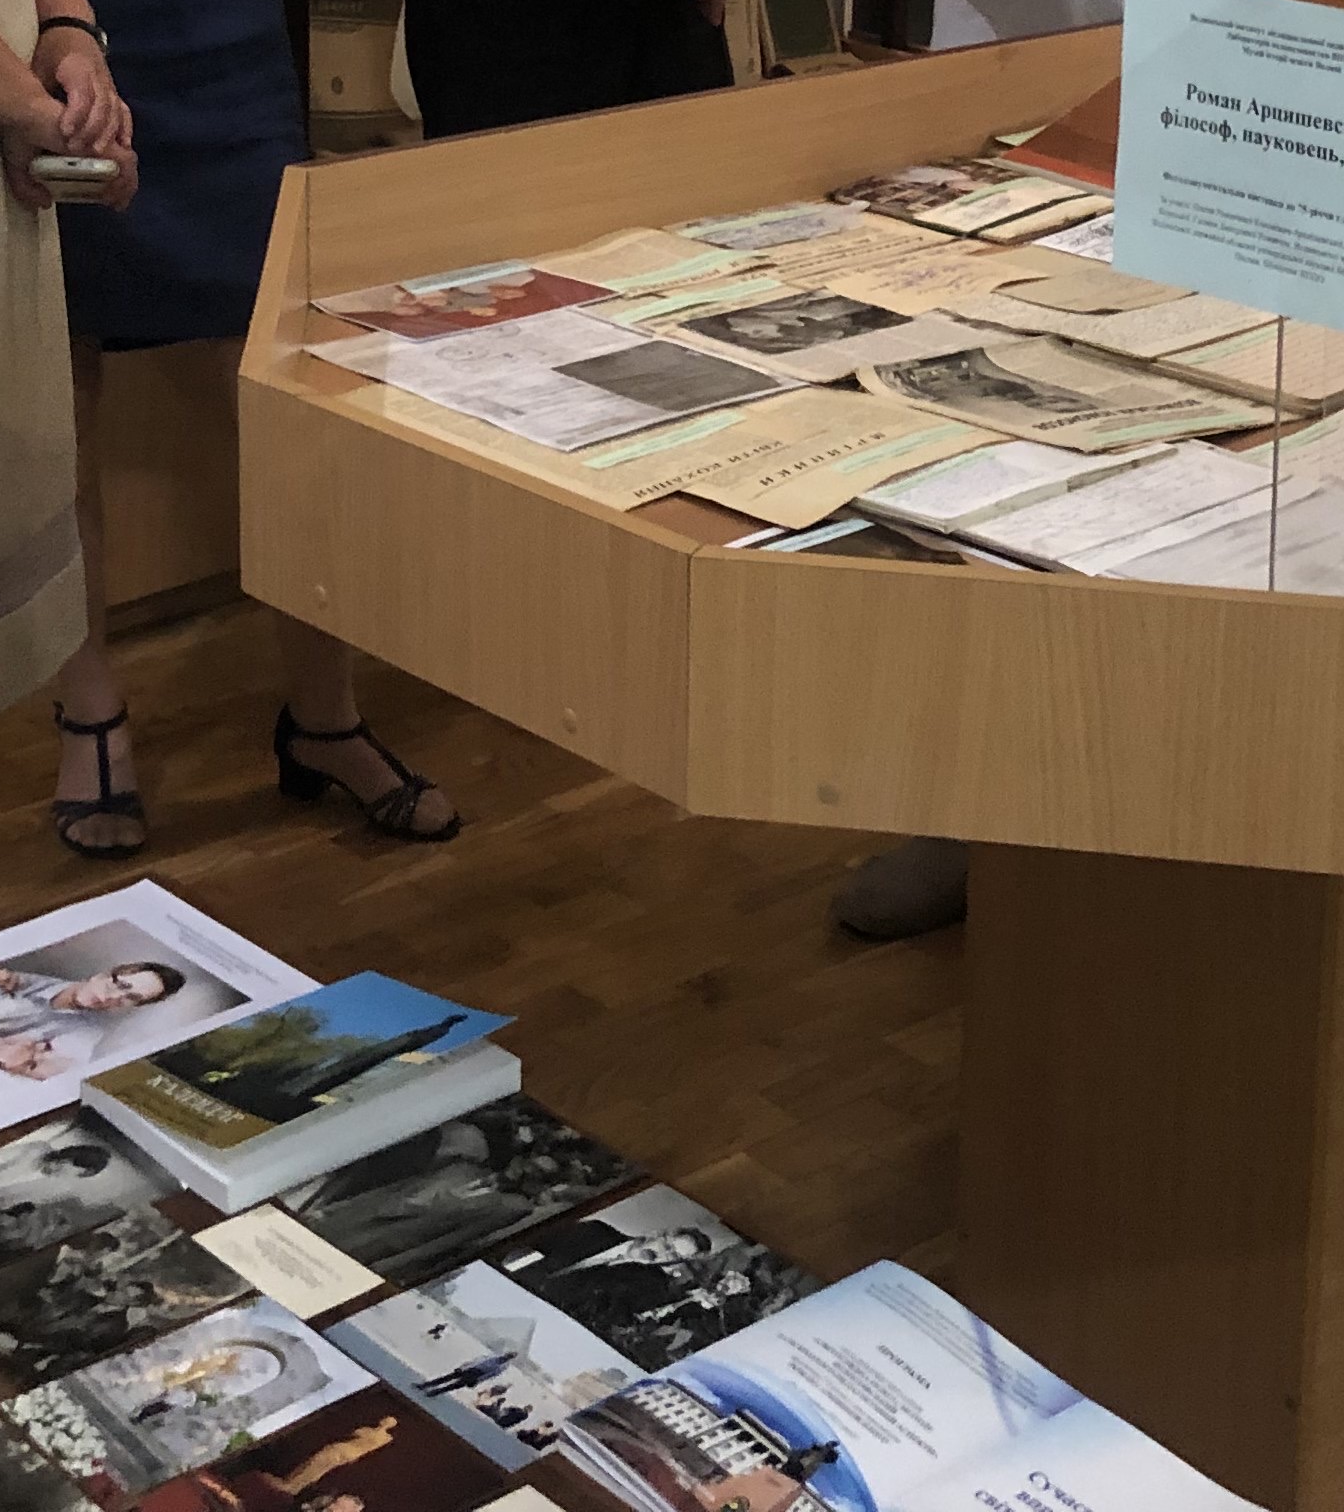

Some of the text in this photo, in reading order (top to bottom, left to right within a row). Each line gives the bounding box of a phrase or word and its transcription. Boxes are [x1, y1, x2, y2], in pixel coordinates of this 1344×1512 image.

[1186, 83, 1242, 113] Роман
[1159, 106, 1237, 144] філософ,
[1241, 127, 1344, 168] науковець,
